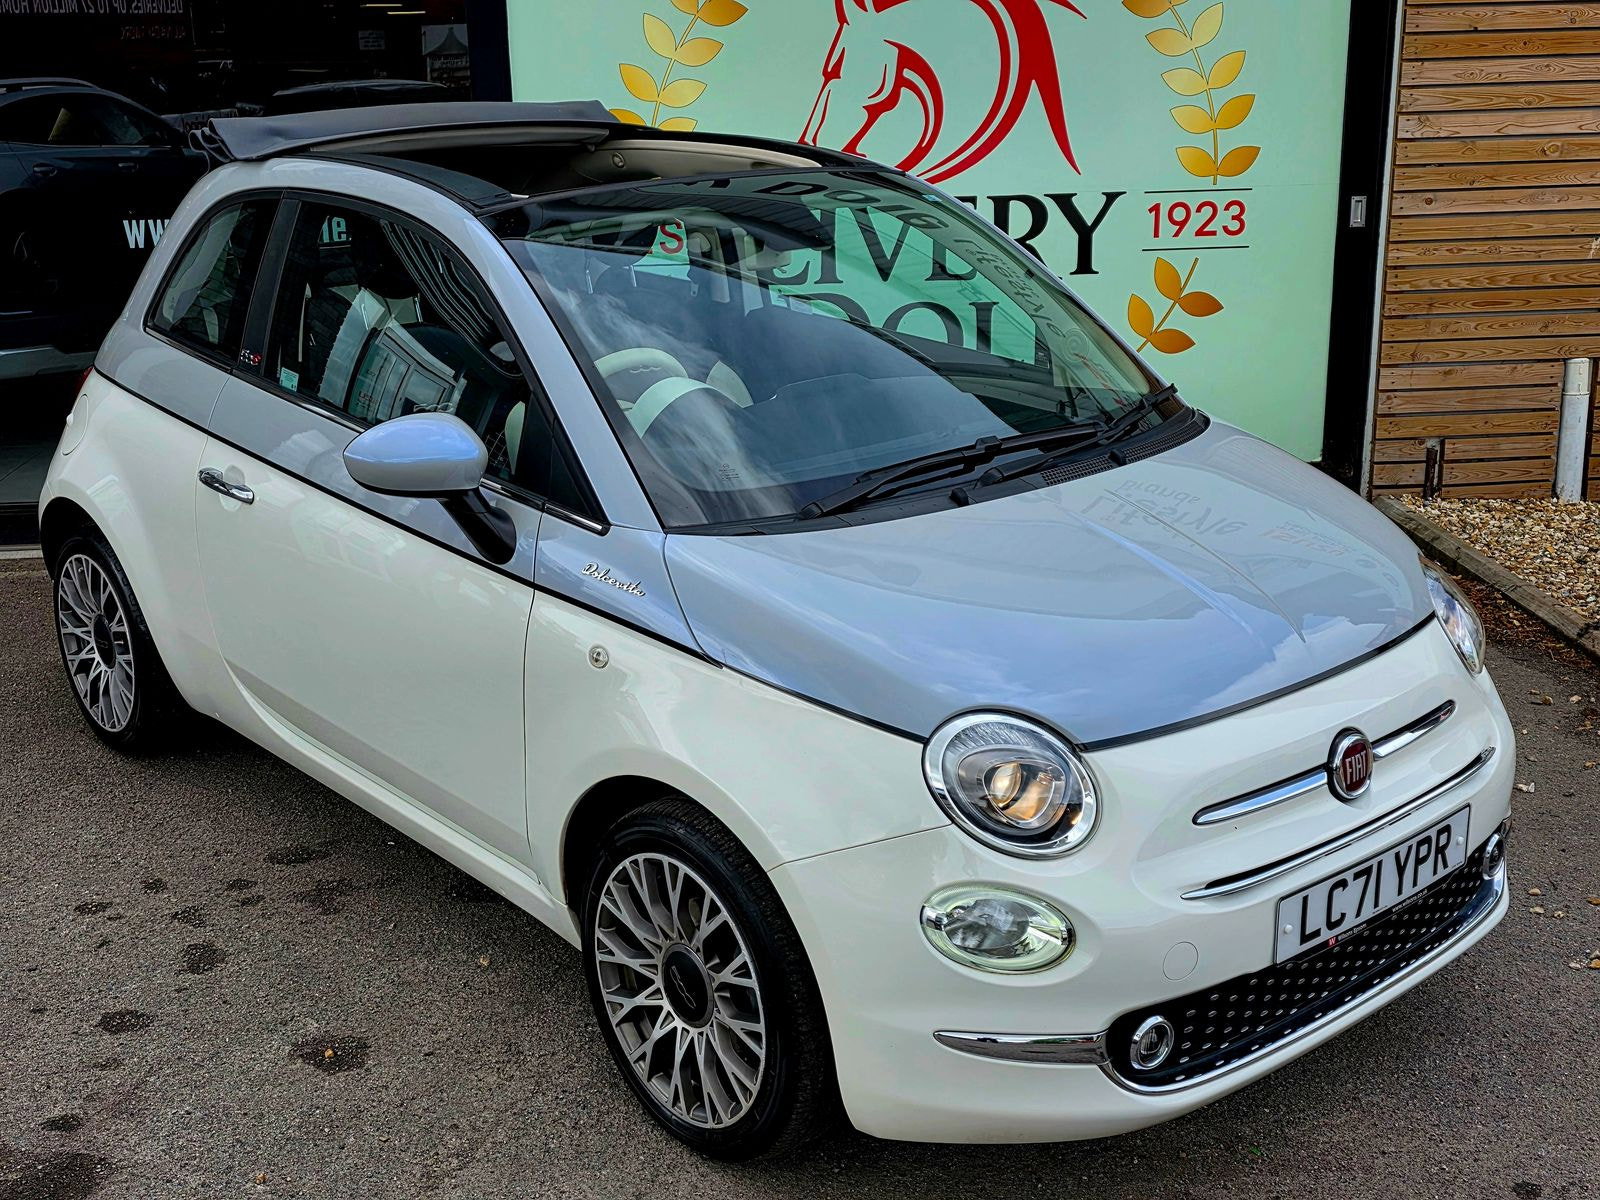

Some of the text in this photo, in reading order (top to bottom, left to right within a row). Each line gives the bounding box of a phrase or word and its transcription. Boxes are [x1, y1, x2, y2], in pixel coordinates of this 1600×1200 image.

[1147, 199, 1246, 239] 1923
[1345, 751, 1367, 785] FIAT
[1300, 824, 1452, 945] LC71 YPR
[1328, 936, 1337, 946] W
